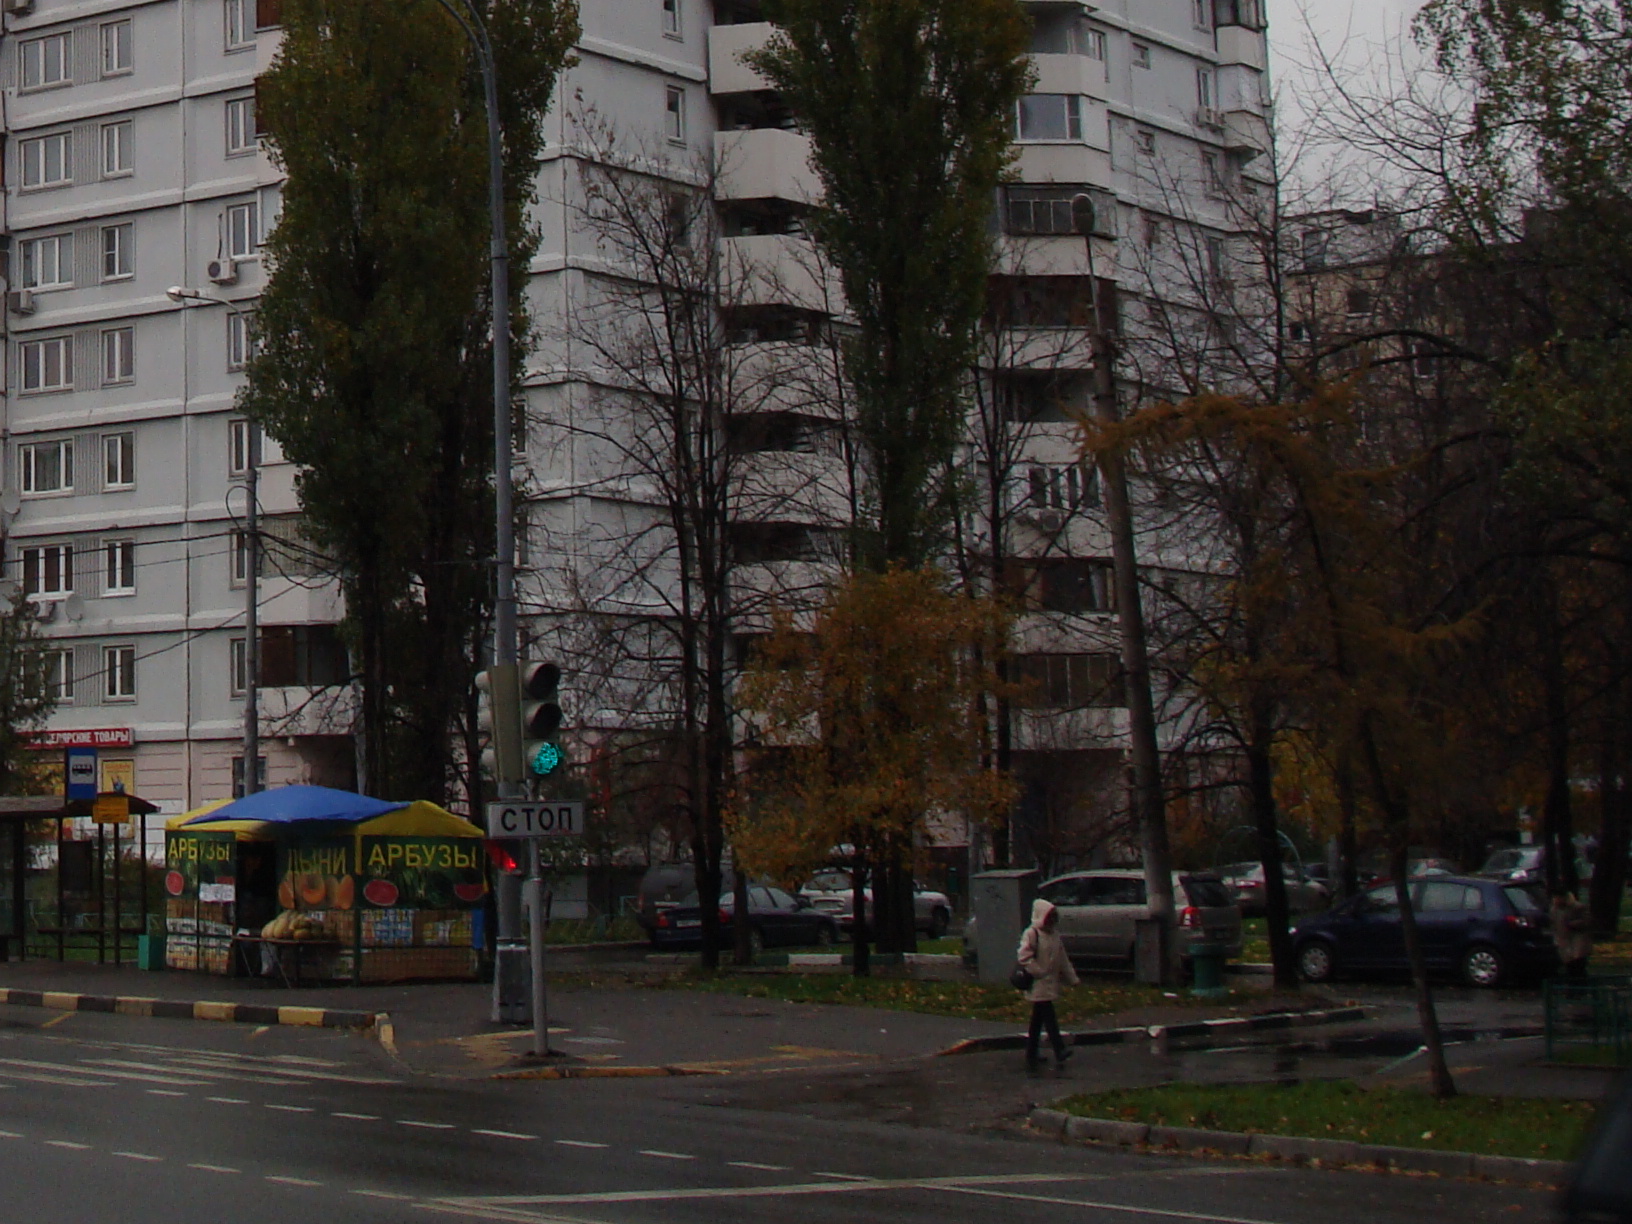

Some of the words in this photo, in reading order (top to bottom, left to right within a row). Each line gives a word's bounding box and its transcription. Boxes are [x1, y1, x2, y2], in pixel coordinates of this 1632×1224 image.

[93, 730, 129, 743] ТОВАРЫ
[501, 807, 572, 831] СТОП
[168, 838, 230, 861] АРБУЗЫ
[287, 846, 347, 875] ДЫНИ
[368, 843, 477, 869] АРБУЗЫ
